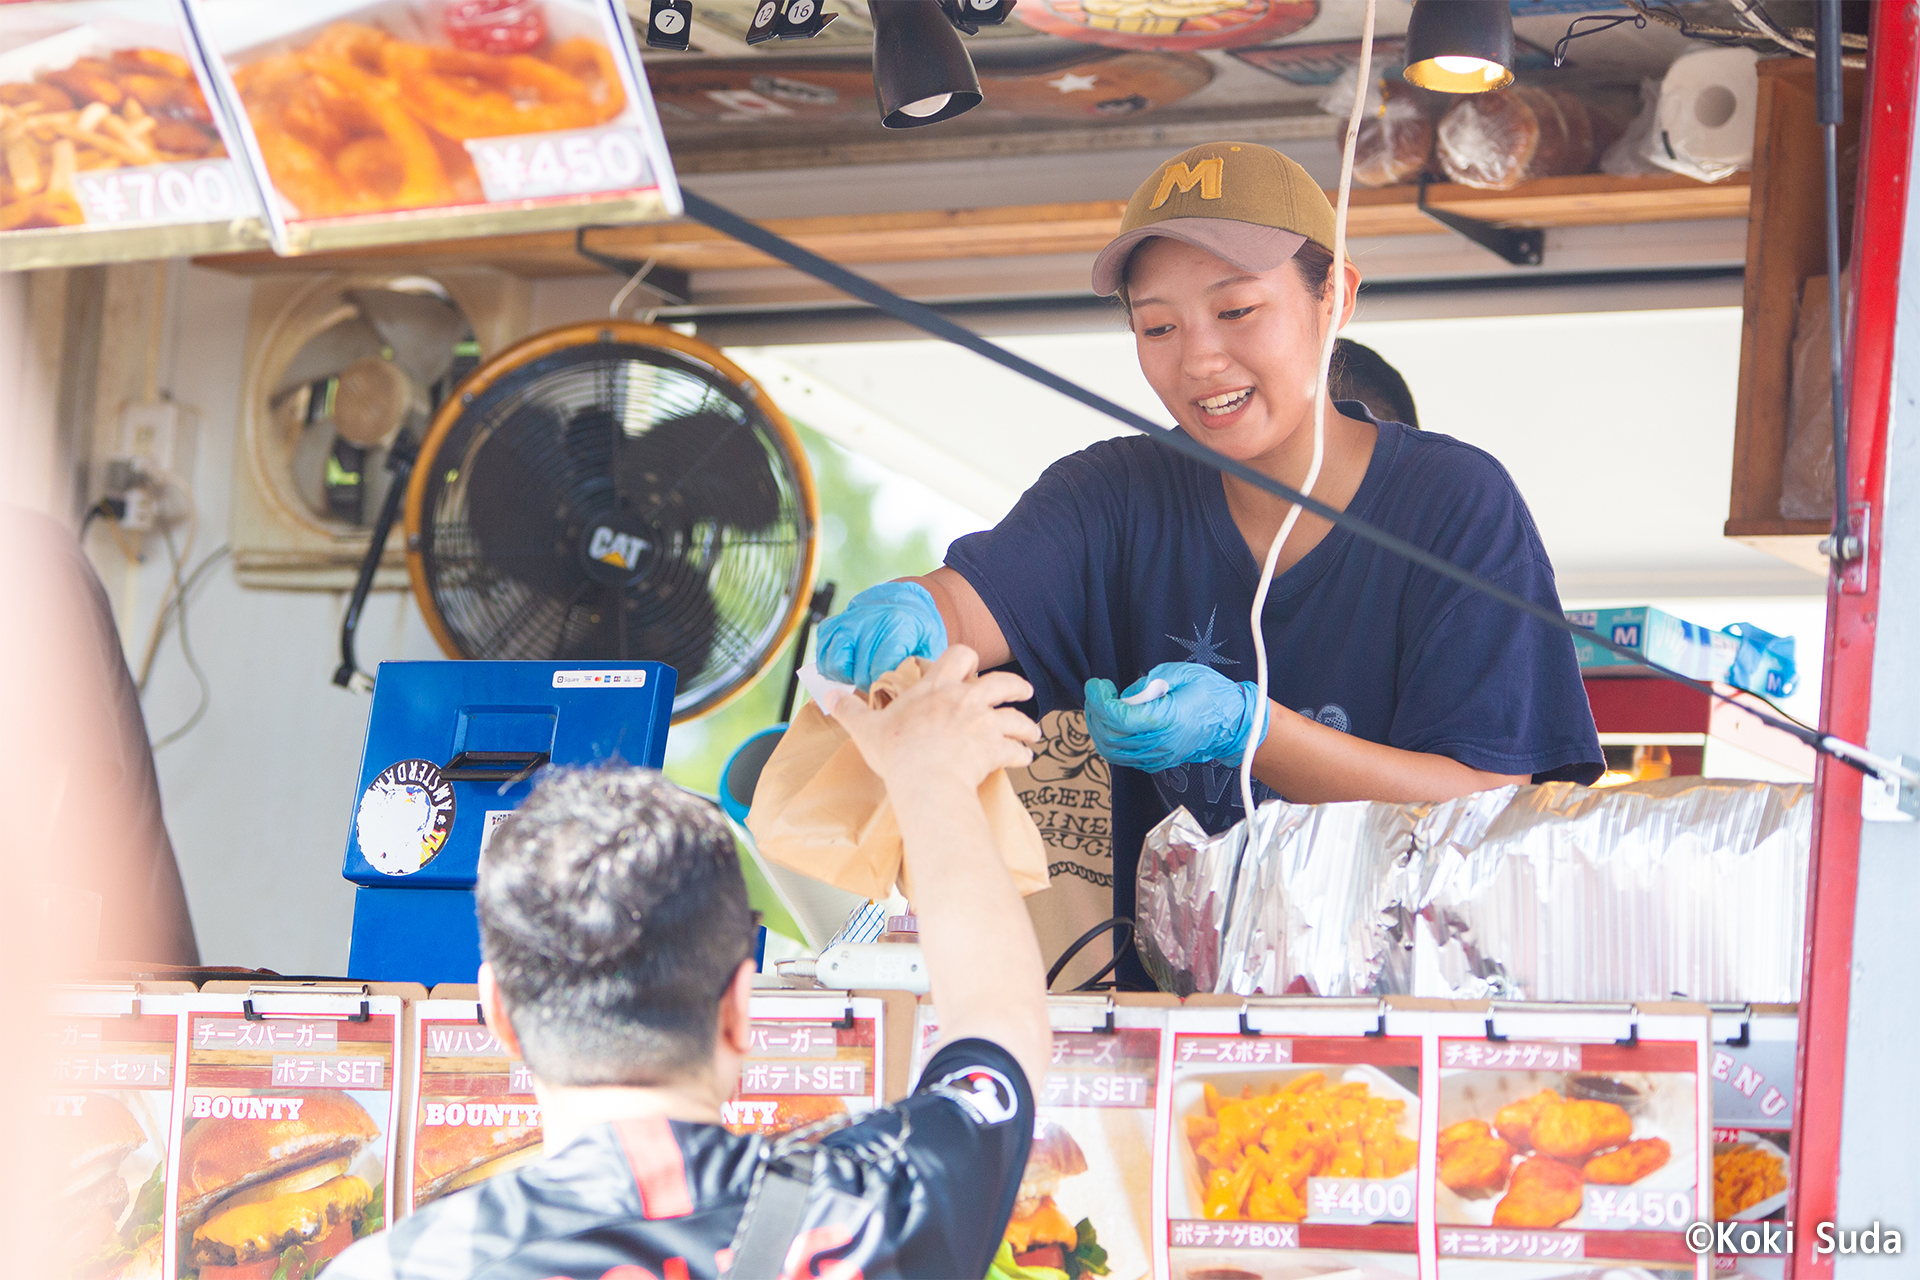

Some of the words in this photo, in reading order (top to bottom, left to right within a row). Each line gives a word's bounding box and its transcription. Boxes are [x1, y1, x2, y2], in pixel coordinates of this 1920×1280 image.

[665, 14, 676, 28] 7
[757, 7, 772, 23] 12
[793, 4, 810, 18] 16
[484, 132, 643, 194] ¥450
[81, 164, 230, 222] ¥700
[1149, 156, 1224, 210] M
[588, 526, 651, 571] CAT
[1613, 626, 1638, 647] M
[1017, 786, 1112, 811] RGER
[1030, 811, 1112, 836] DINE
[198, 1022, 335, 1047] チーズバーガー
[1180, 1041, 1290, 1063] チーズポテト
[1444, 1044, 1579, 1068] チキンナゲット
[50, 1057, 167, 1083] ポテトセット
[276, 1058, 382, 1084] ポテトSET
[746, 1064, 862, 1091] ポテトSET
[1044, 1076, 1143, 1102] テトSET
[1711, 1050, 1789, 1118] ENU
[191, 1095, 304, 1120] BOUNTY
[425, 1103, 541, 1127] BOUNTY
[1313, 1182, 1412, 1218] ¥400
[1589, 1189, 1692, 1228] ¥450
[1174, 1225, 1296, 1248] ポテナゲBOX
[1442, 1231, 1582, 1258] オニオンリング
